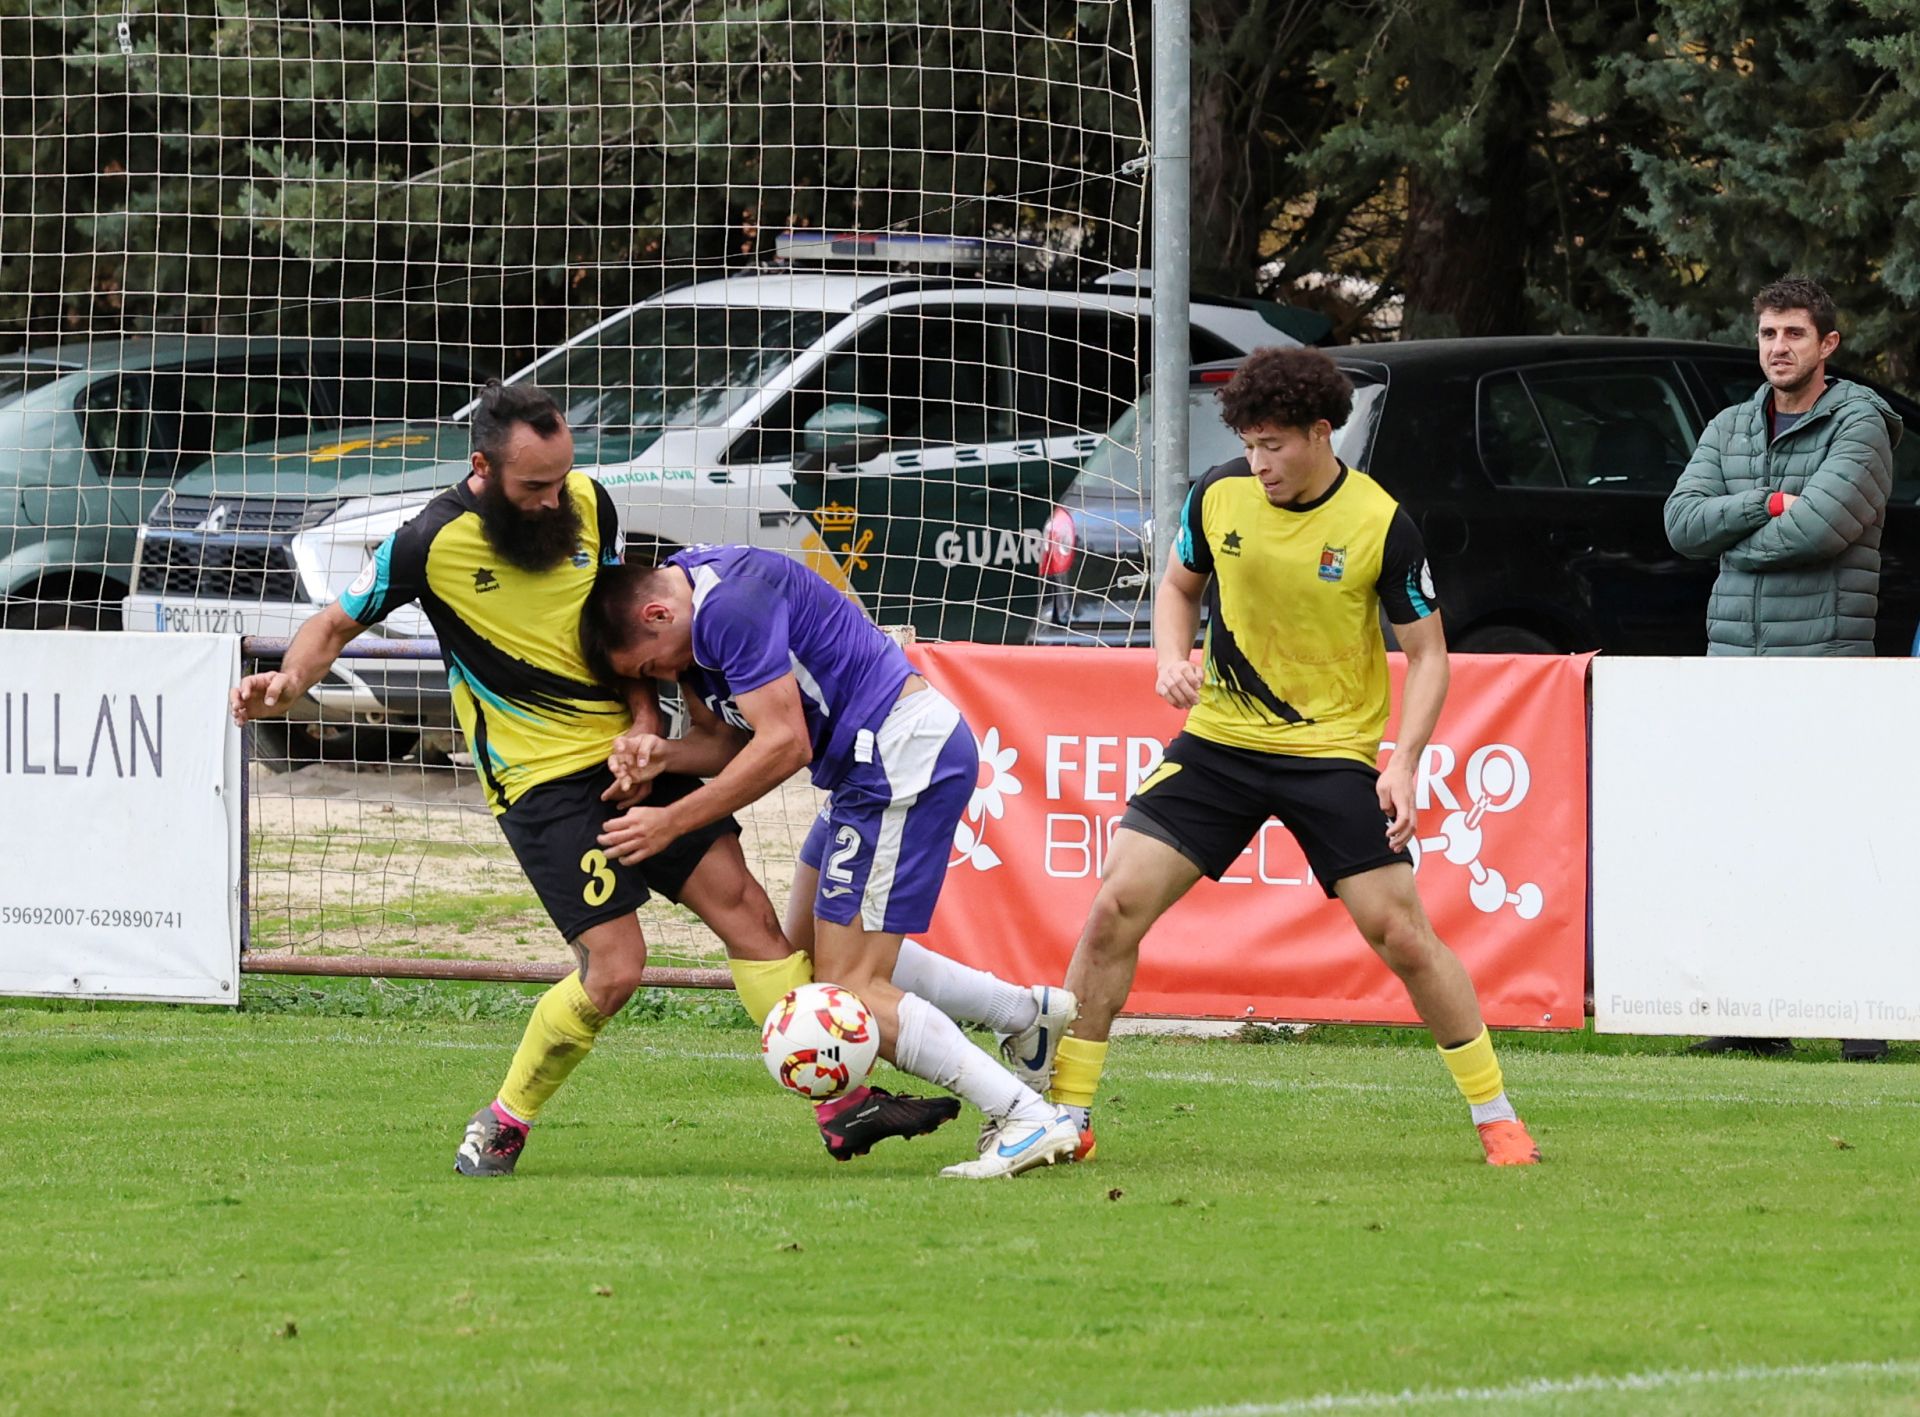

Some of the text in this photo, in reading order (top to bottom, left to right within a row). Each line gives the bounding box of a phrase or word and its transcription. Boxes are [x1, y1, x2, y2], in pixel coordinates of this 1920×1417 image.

[663, 469, 694, 480] CIVIL
[826, 825, 861, 883] 2
[580, 848, 616, 906] 3
[1611, 995, 1682, 1016] Fuentes
[1689, 998, 1710, 1017] de
[1717, 997, 1761, 1017] Nava
[1768, 998, 1857, 1023] (Palencia)
